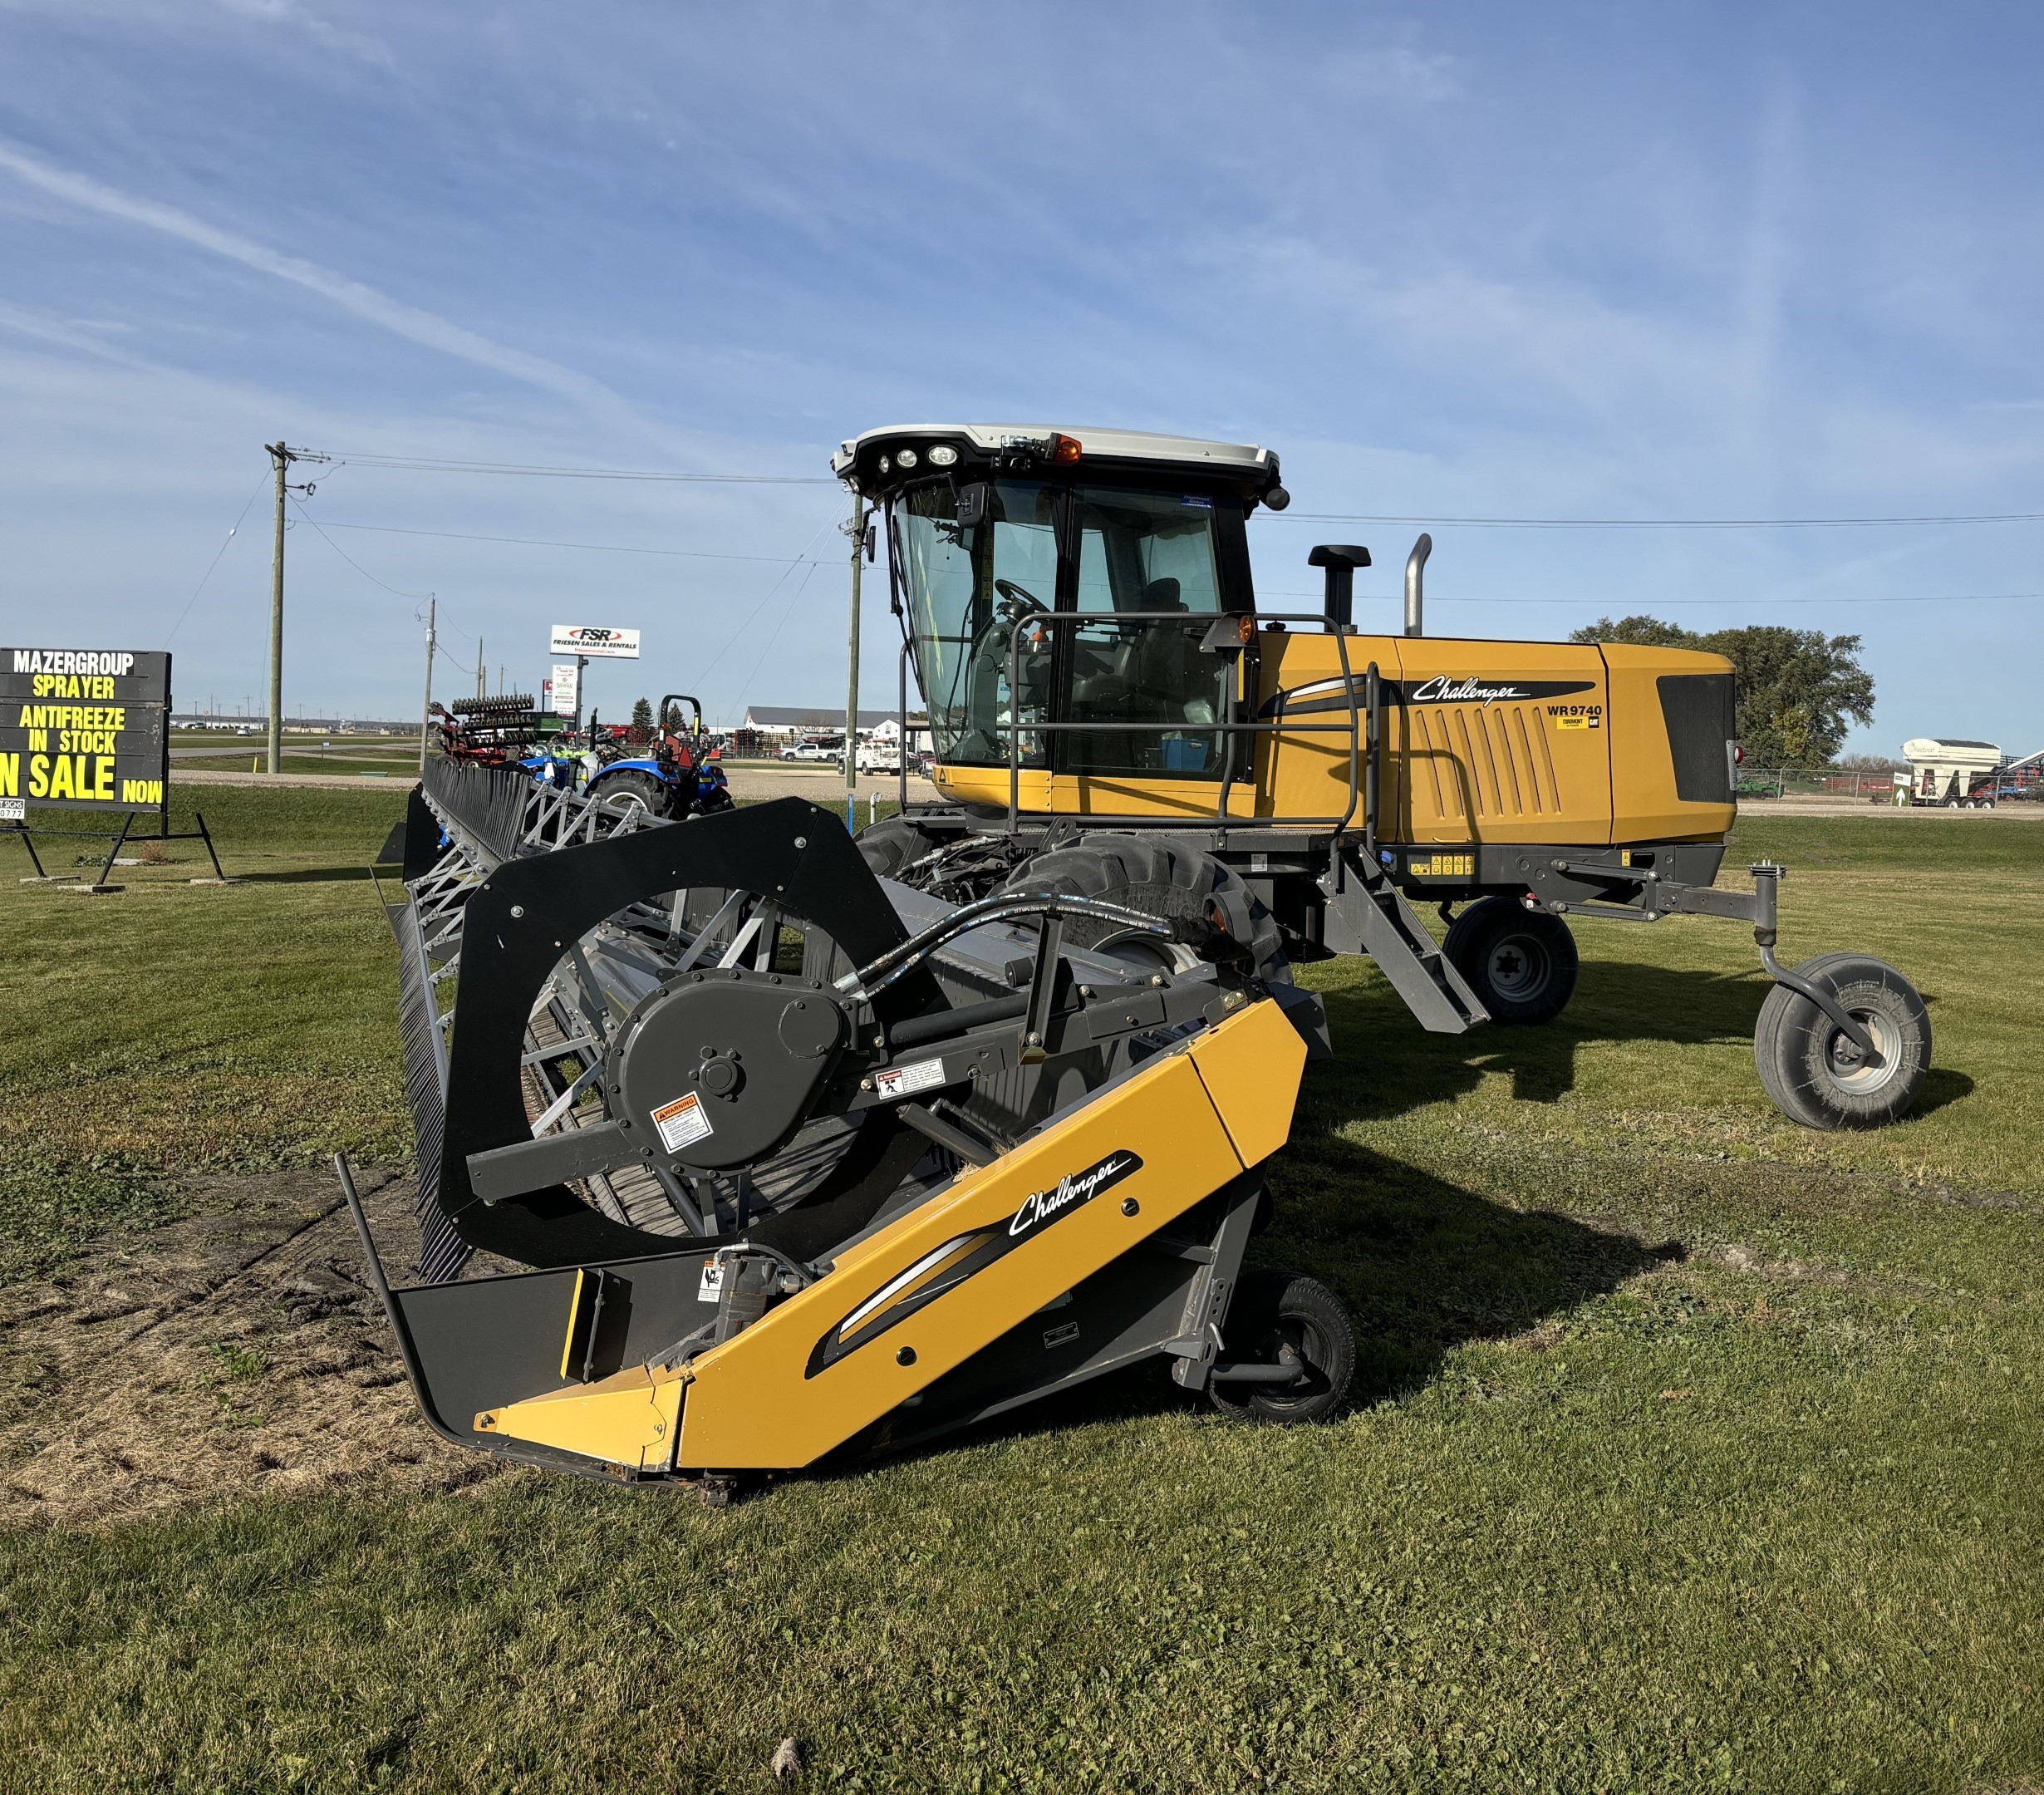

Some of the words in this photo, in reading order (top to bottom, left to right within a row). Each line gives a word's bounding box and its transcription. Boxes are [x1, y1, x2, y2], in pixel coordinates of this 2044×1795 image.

[579, 628, 612, 641] FSR
[13, 650, 134, 676] MAZERGROUP
[32, 674, 115, 699] SPRAYER
[1413, 674, 1531, 708] Challenger
[19, 705, 125, 730] ANTIFREEZE
[28, 728, 47, 751] IN
[59, 730, 116, 754] STOCK
[28, 754, 115, 800] SALE
[122, 779, 163, 804] NOW
[4, 800, 22, 809] SIGNS
[664, 1098, 695, 1116] WARNING
[1008, 1157, 1133, 1237] Challenger
